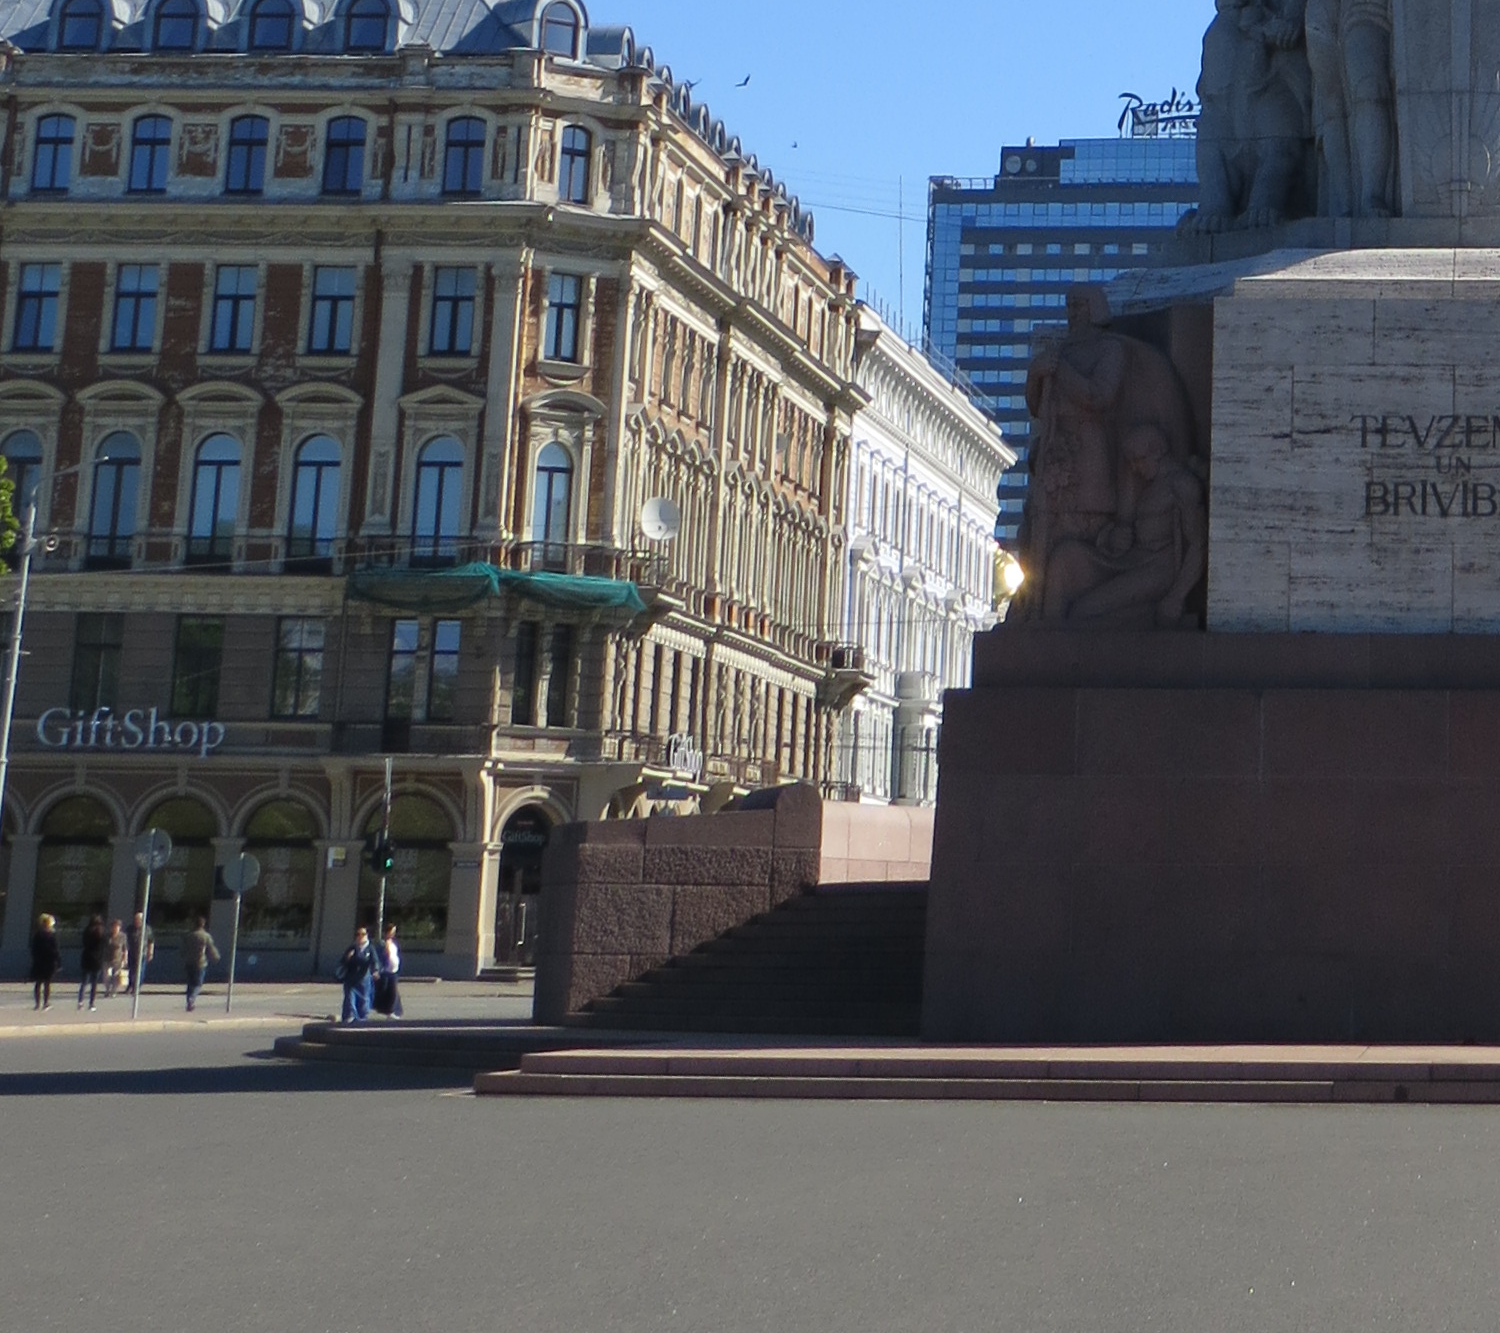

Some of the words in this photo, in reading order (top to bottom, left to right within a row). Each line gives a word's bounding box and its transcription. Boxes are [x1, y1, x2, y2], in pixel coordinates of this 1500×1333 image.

[1118, 86, 1203, 131] Radis
[1435, 456, 1472, 474] UN
[36, 706, 225, 759] GiftShop
